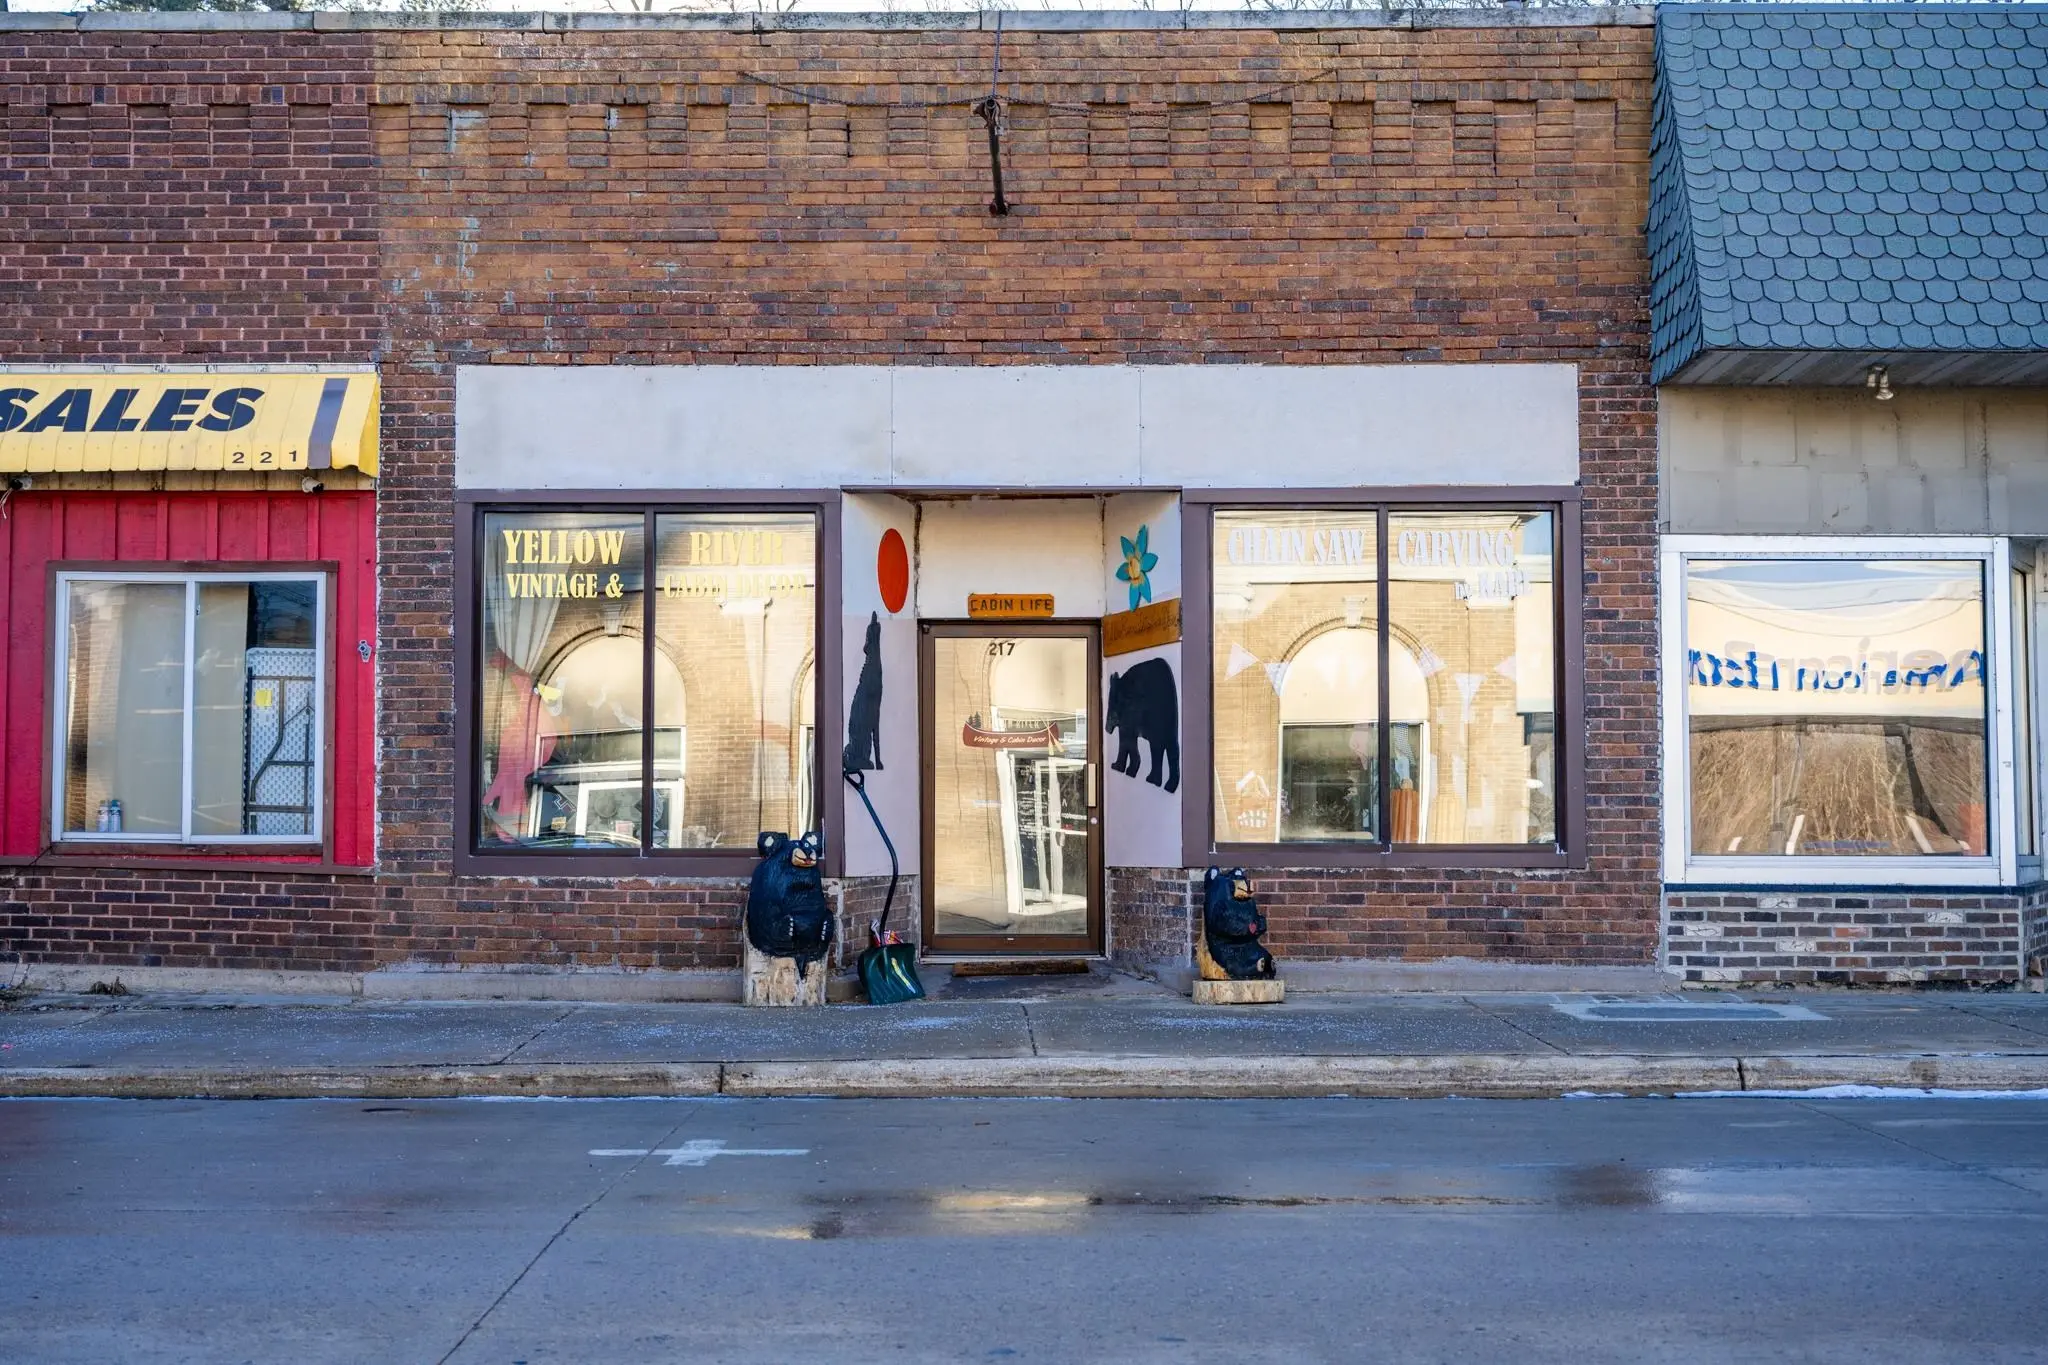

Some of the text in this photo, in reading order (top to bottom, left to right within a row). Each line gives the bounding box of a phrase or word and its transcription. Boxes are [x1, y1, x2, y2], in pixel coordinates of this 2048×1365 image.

[0, 387, 265, 433] SALES
[502, 529, 785, 567] YELLOW RIVER
[1228, 527, 1514, 567] CHAIN SAW CARVING
[506, 573, 598, 599] VINTAGE
[605, 573, 624, 599] &
[664, 573, 728, 599] CABIN
[970, 598, 1053, 611] CABIN LIFE
[989, 642, 1016, 656] 217
